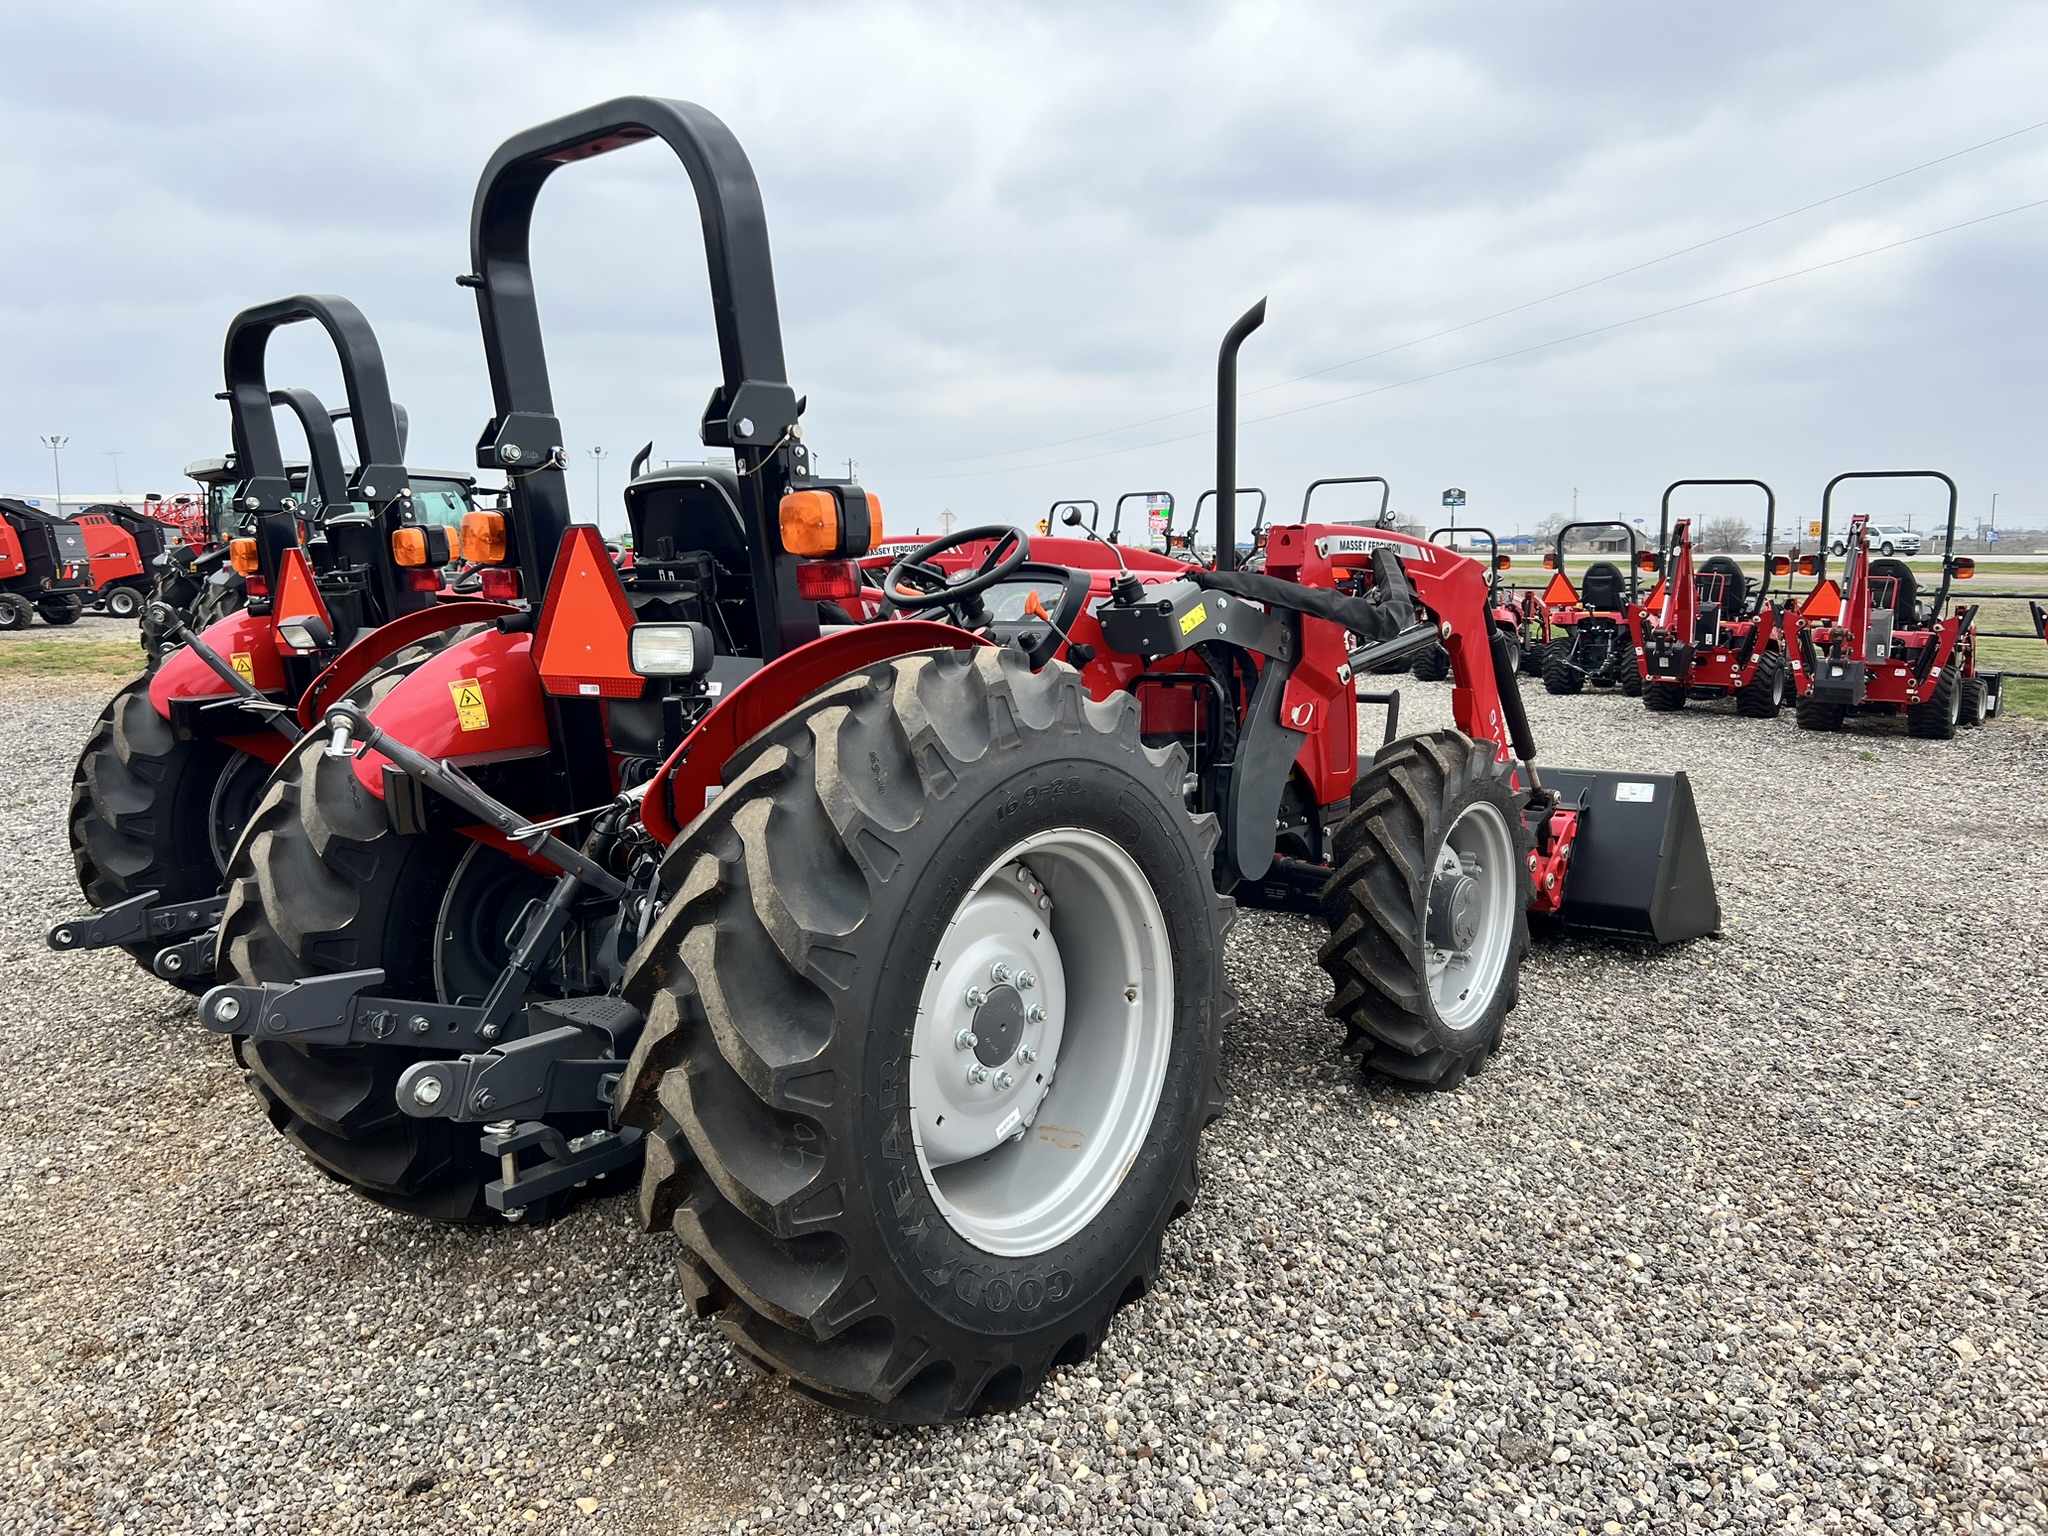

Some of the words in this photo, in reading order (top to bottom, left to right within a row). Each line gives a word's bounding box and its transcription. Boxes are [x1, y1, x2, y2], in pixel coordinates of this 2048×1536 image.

[892, 544, 926, 554] FERGUSO
[1339, 540, 1367, 551] MASSEY
[996, 775, 1082, 823] 16.9-28
